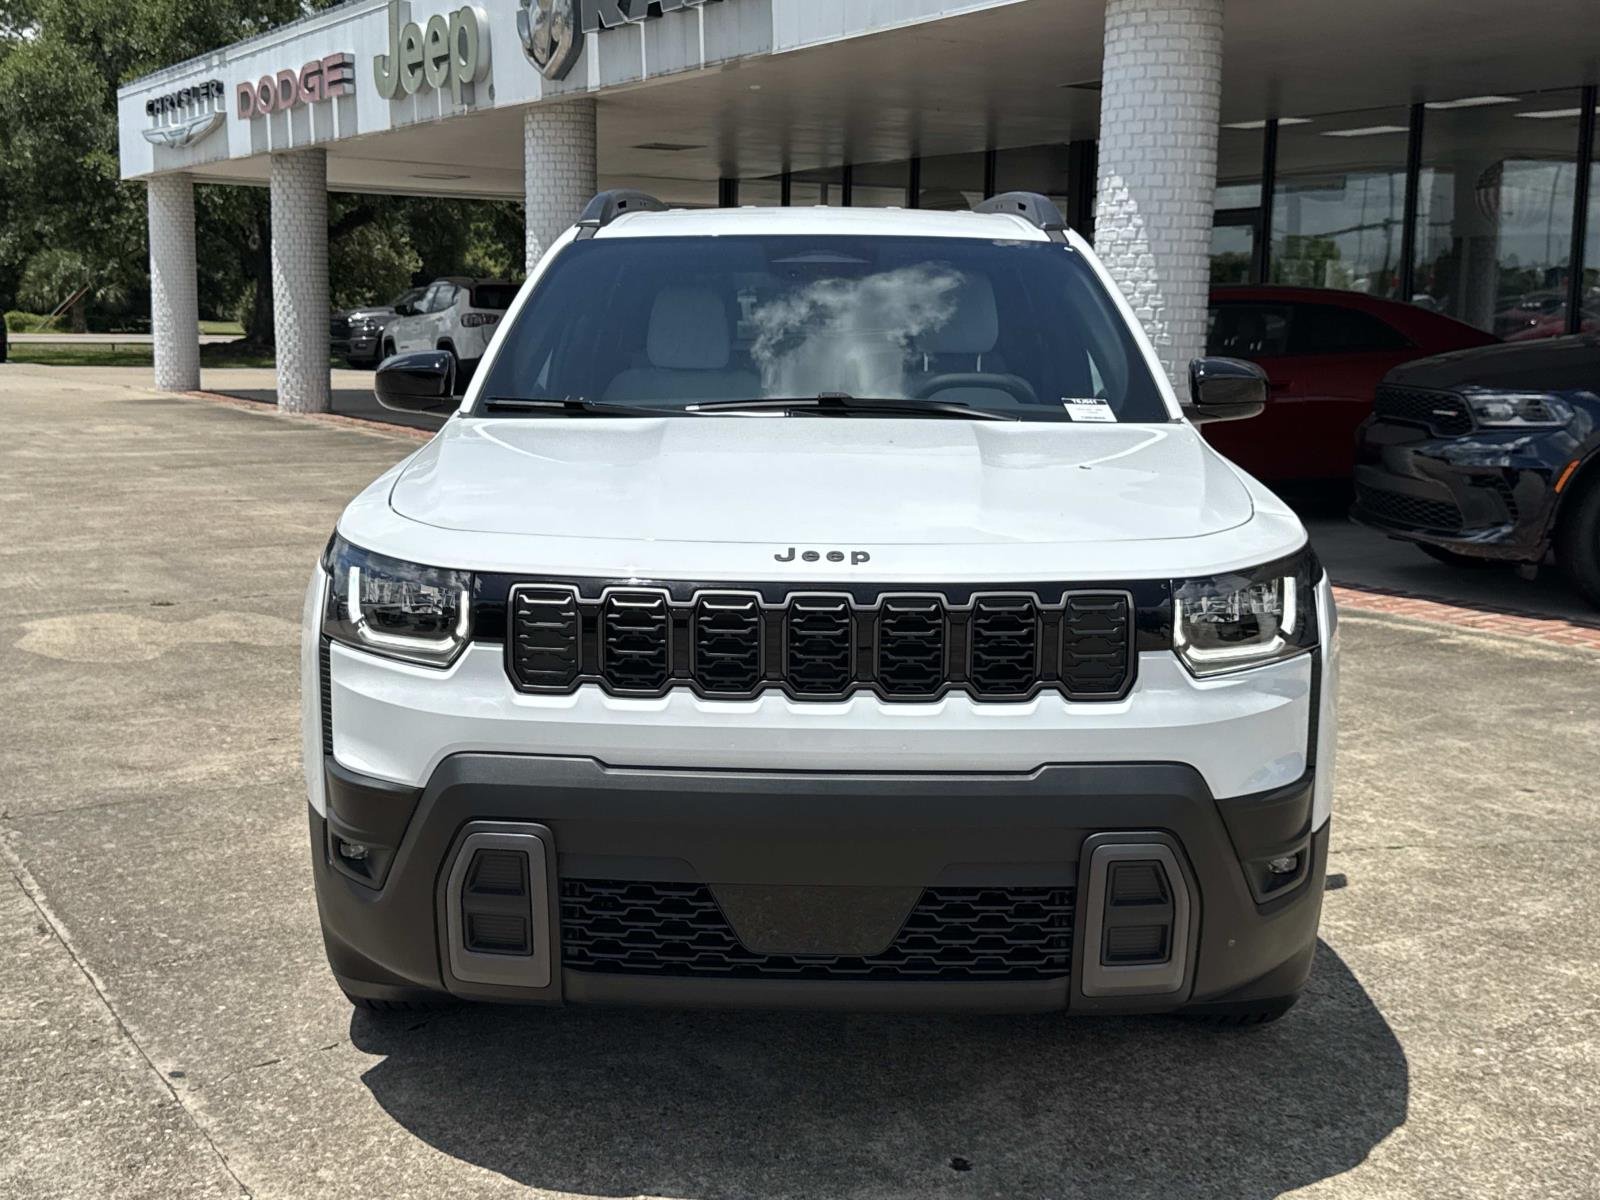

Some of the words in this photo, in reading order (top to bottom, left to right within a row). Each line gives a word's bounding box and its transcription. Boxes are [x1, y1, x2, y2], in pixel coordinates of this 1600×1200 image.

[374, 0, 488, 105] Jeep
[146, 79, 224, 117] CHRYSLER
[237, 52, 355, 120] DODGE
[774, 547, 871, 566] Jeep
